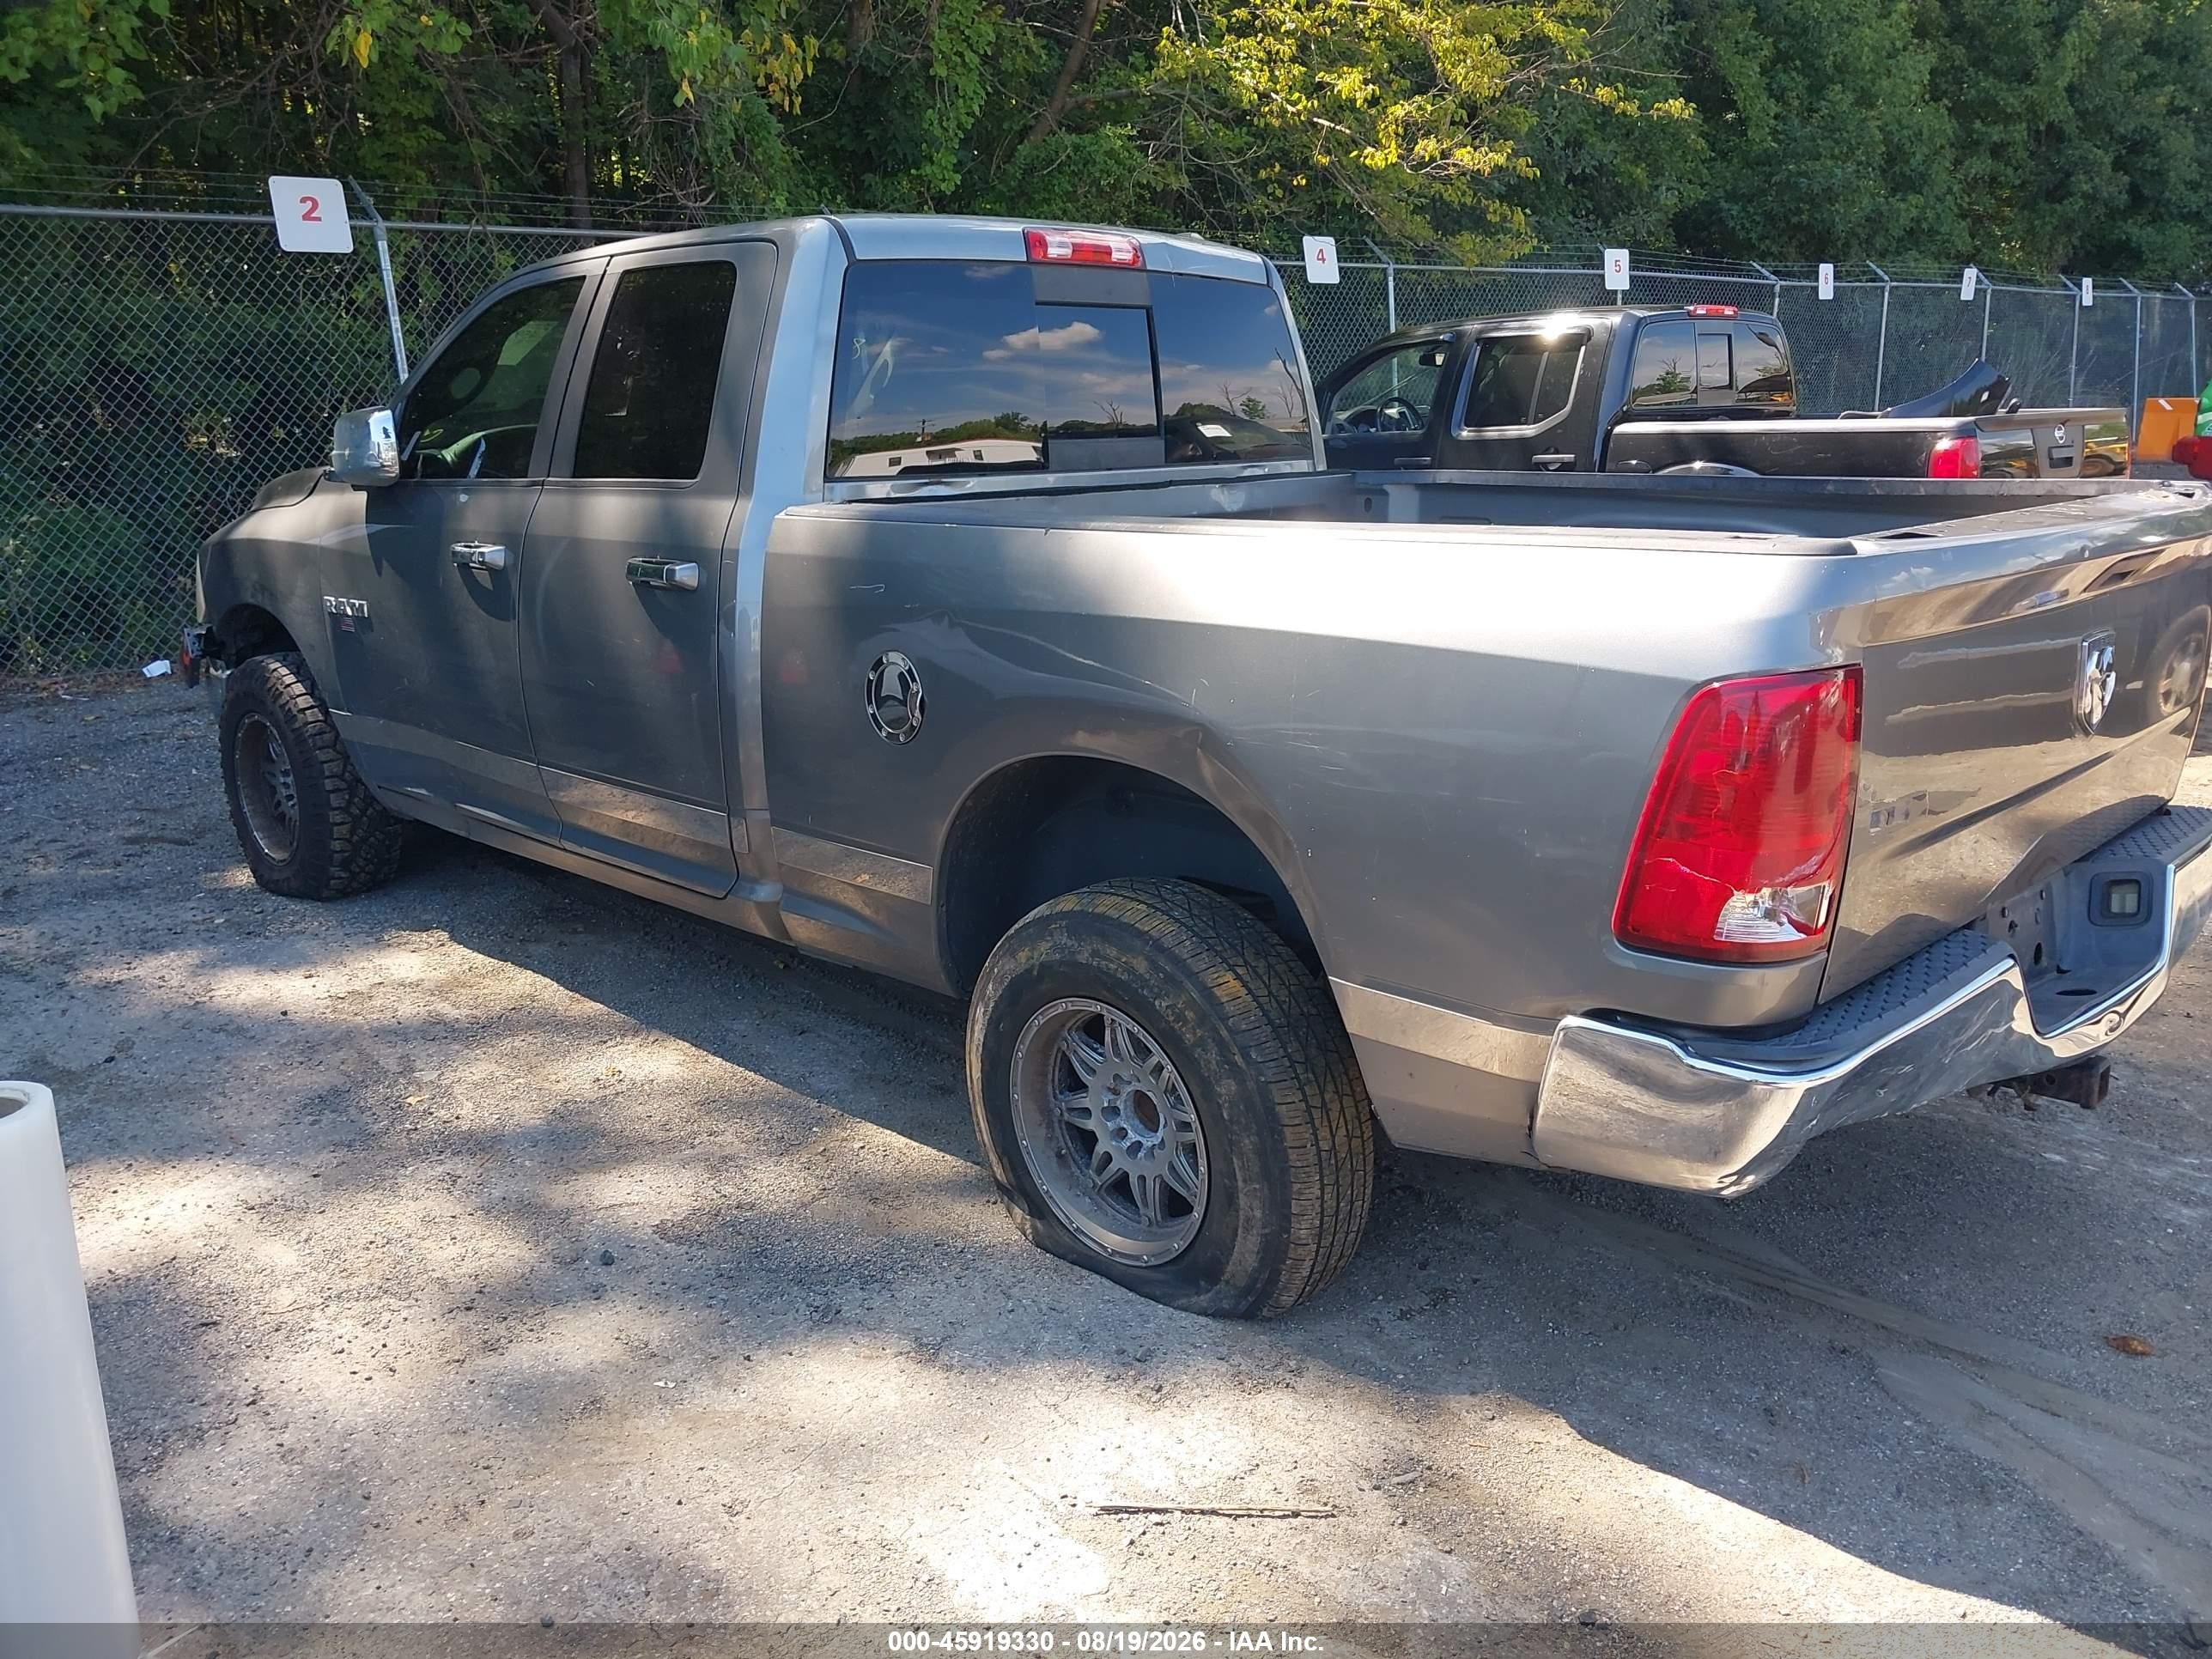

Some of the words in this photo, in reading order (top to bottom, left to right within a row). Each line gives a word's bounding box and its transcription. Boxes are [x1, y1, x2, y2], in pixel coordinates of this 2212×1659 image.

[299, 196, 322, 222] 2
[1316, 248, 1327, 264] 4
[1614, 259, 1622, 274] 5
[1824, 272, 1829, 284] 6
[1967, 276, 1972, 288] 7
[323, 595, 369, 618] RAM
